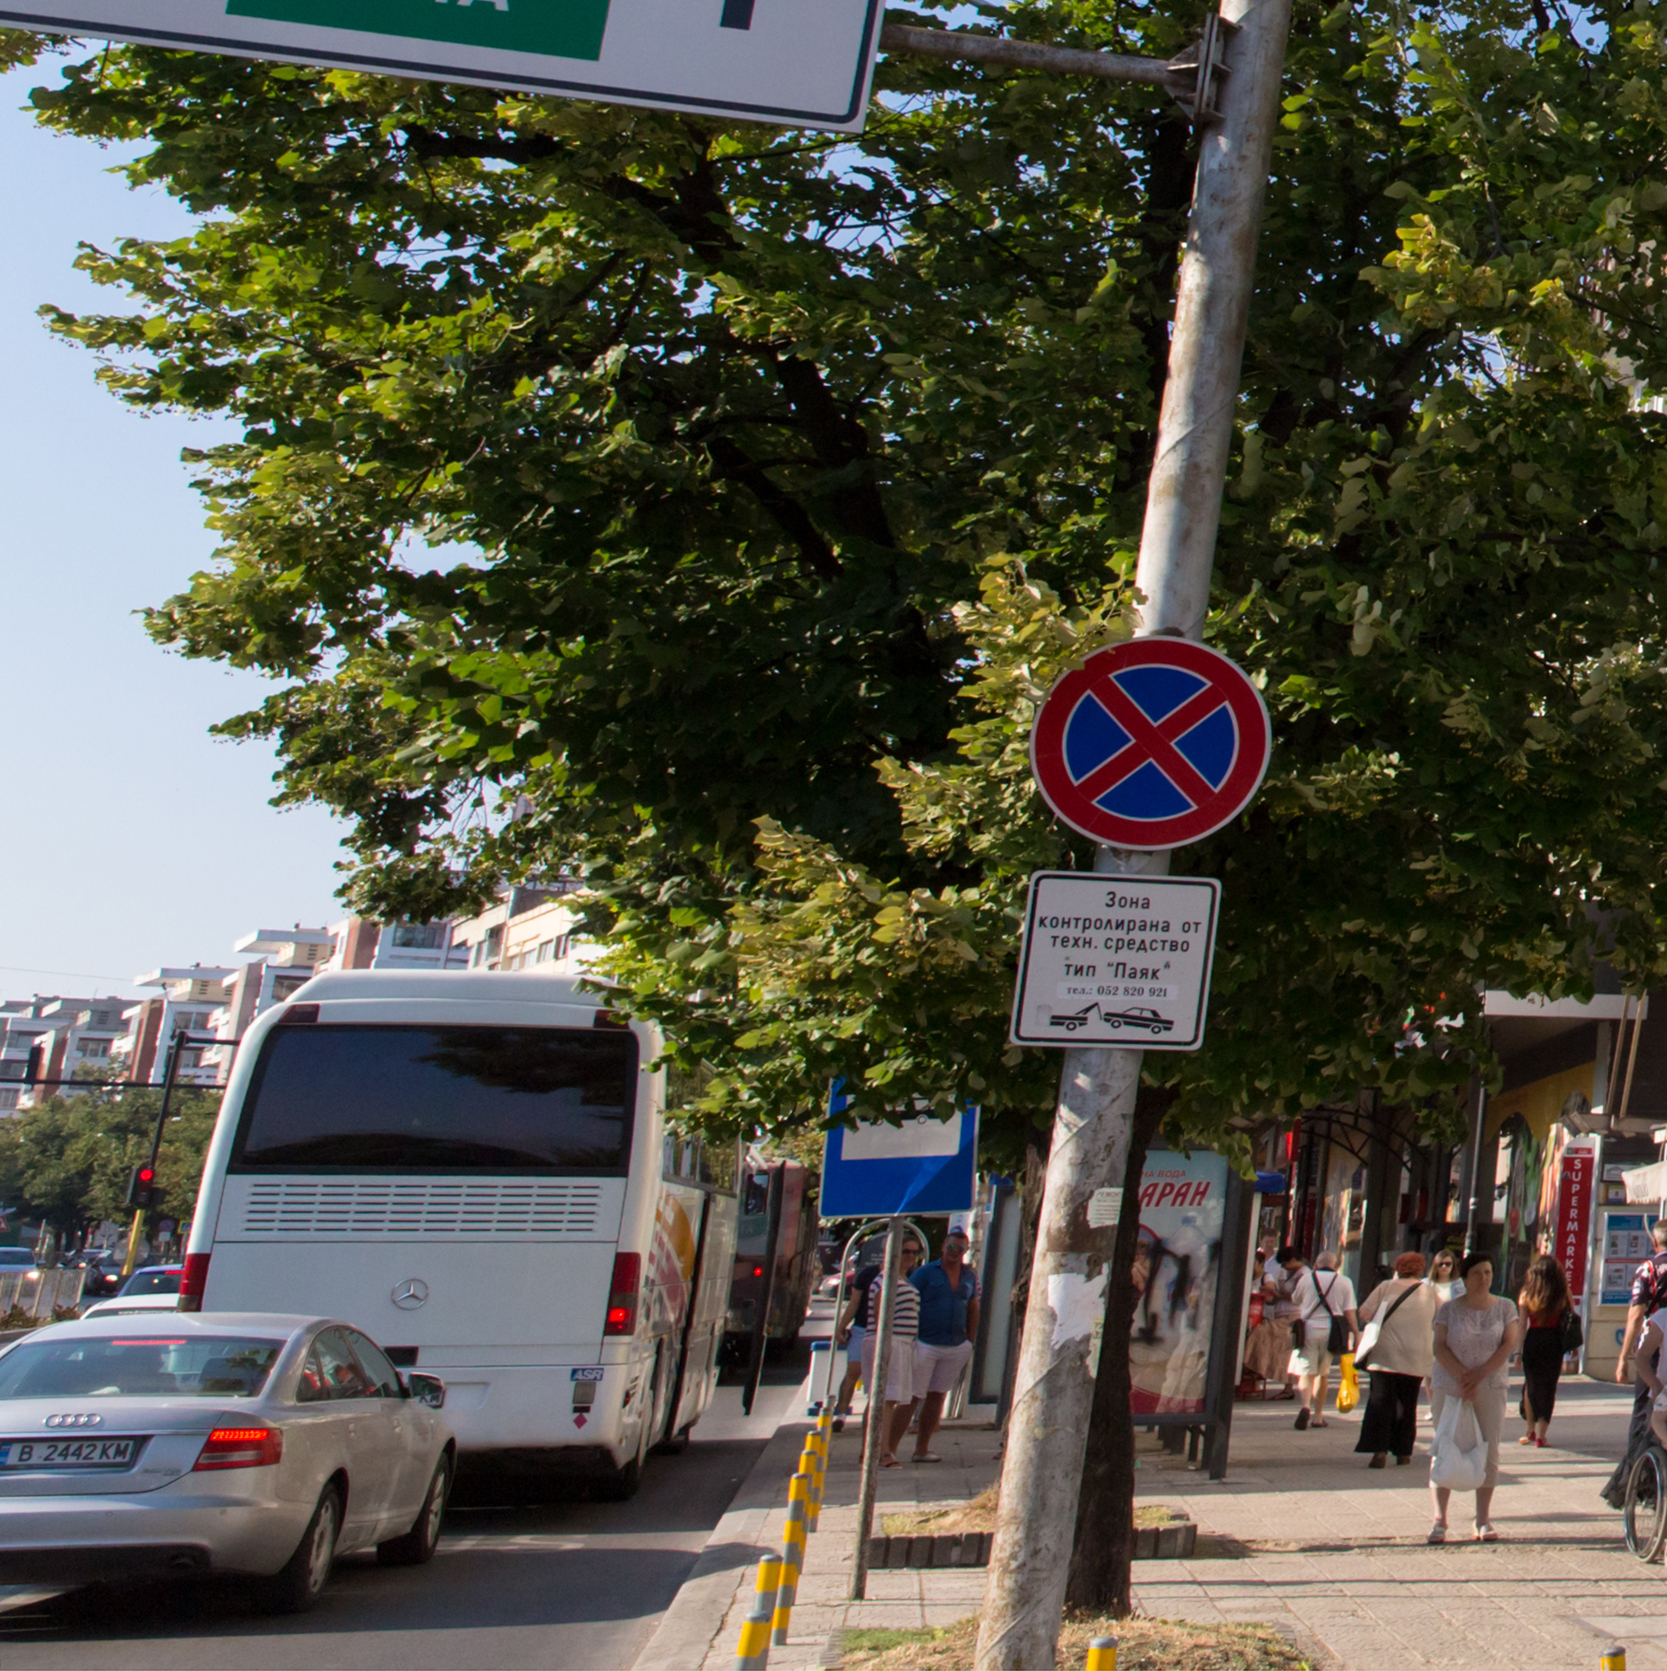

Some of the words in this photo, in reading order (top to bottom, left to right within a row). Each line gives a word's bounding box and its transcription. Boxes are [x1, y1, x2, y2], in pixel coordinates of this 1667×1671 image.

[1104, 890, 1151, 910] Зона
[1038, 915, 1171, 936] контролирана
[1181, 920, 1202, 934] от
[1050, 934, 1099, 950] техн.
[1103, 936, 1191, 954] средство
[1064, 963, 1097, 978] тип
[1096, 984, 1119, 997] 052
[1122, 985, 1145, 997] 820
[1148, 986, 1168, 998] 921
[1157, 1169, 1187, 1179] ВОДА
[1140, 1181, 1212, 1208] АРАН
[1564, 1158, 1583, 1288] SUPERMARKE
[572, 1368, 604, 1381] ASR
[17, 1444, 34, 1463] B
[43, 1442, 96, 1462] 2442
[99, 1442, 132, 1461] KM
